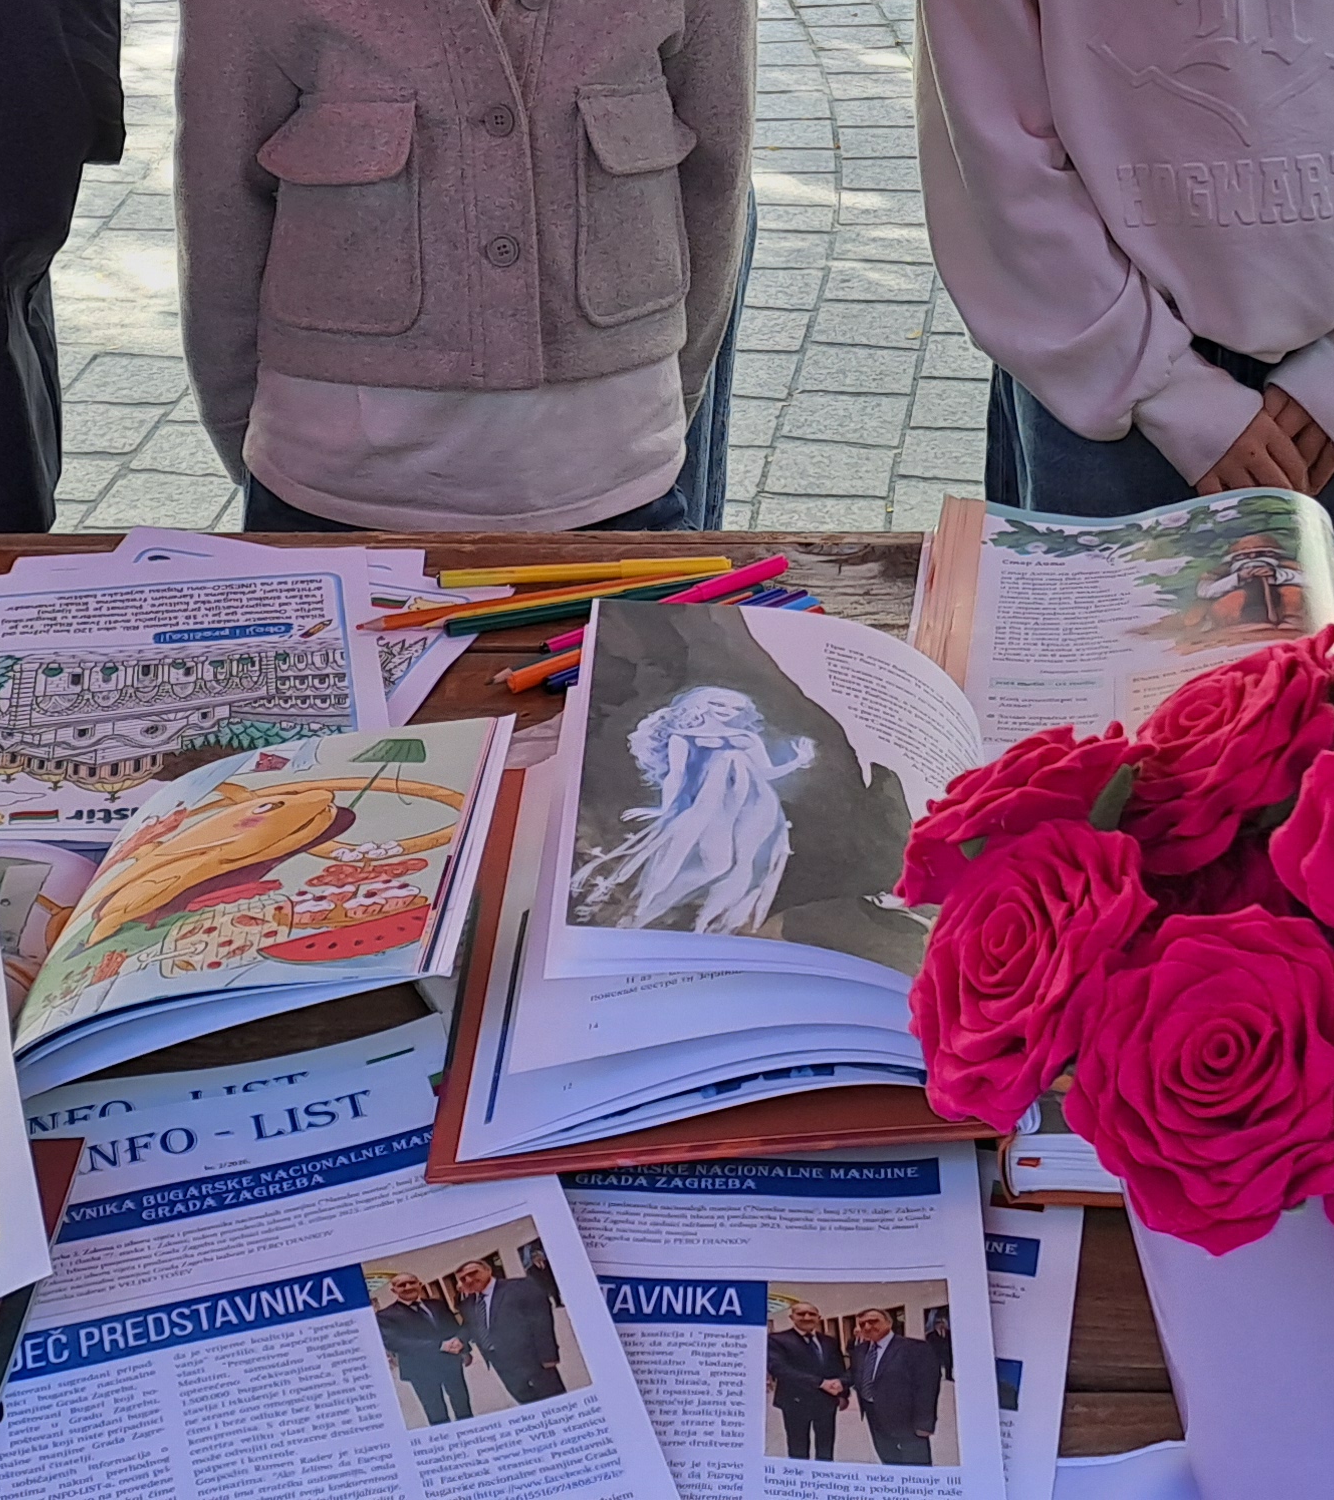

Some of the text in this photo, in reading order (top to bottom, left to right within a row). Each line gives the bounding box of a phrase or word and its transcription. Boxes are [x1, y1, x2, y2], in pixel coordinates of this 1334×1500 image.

[78, 1088, 372, 1177] NFO LIST
[140, 1173, 326, 1223] GRADA ZAGREBA
[141, 1174, 256, 1208] BUGARSKE
[260, 1143, 389, 1184] NACIONALNE
[575, 1172, 758, 1191] GRADA ZAGREBA
[695, 1163, 920, 1181] NACIONALNE MANJINE
[77, 1275, 347, 1358] PREDSTAVNIKA
